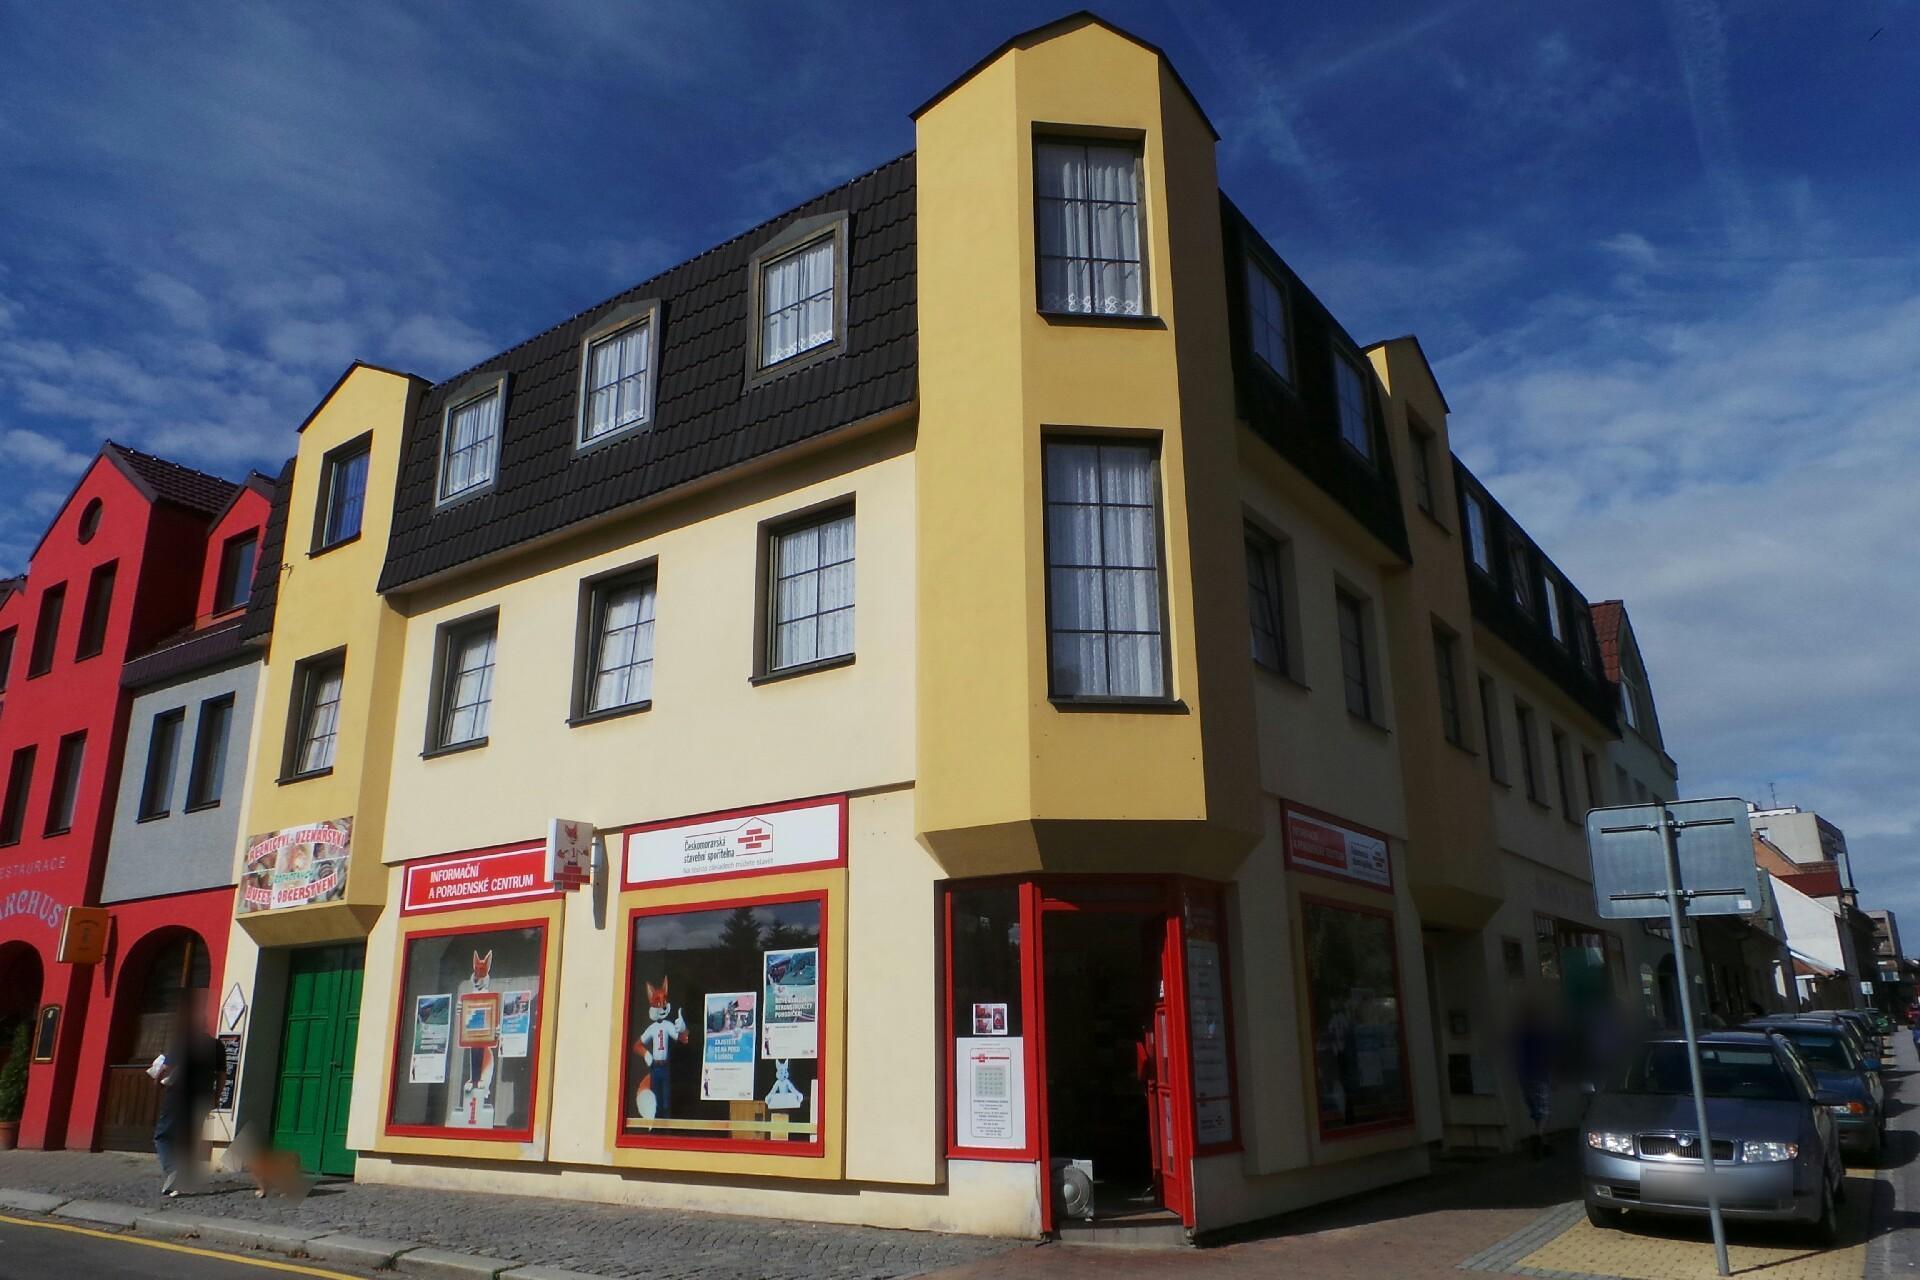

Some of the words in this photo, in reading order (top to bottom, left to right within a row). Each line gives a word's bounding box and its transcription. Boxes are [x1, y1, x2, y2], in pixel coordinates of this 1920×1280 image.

[684, 852, 705, 863] stavební
[707, 848, 734, 862] spořitelna
[685, 837, 725, 851] Českomoravská
[0, 857, 65, 880] ESTAURACE
[430, 862, 480, 883] INFORMAČNÍ
[428, 887, 434, 899] A
[436, 877, 489, 899] PORADENSKÉ
[491, 873, 533, 891] CENTRUM
[0, 890, 63, 928] KCHUS
[468, 1097, 477, 1125] 1
